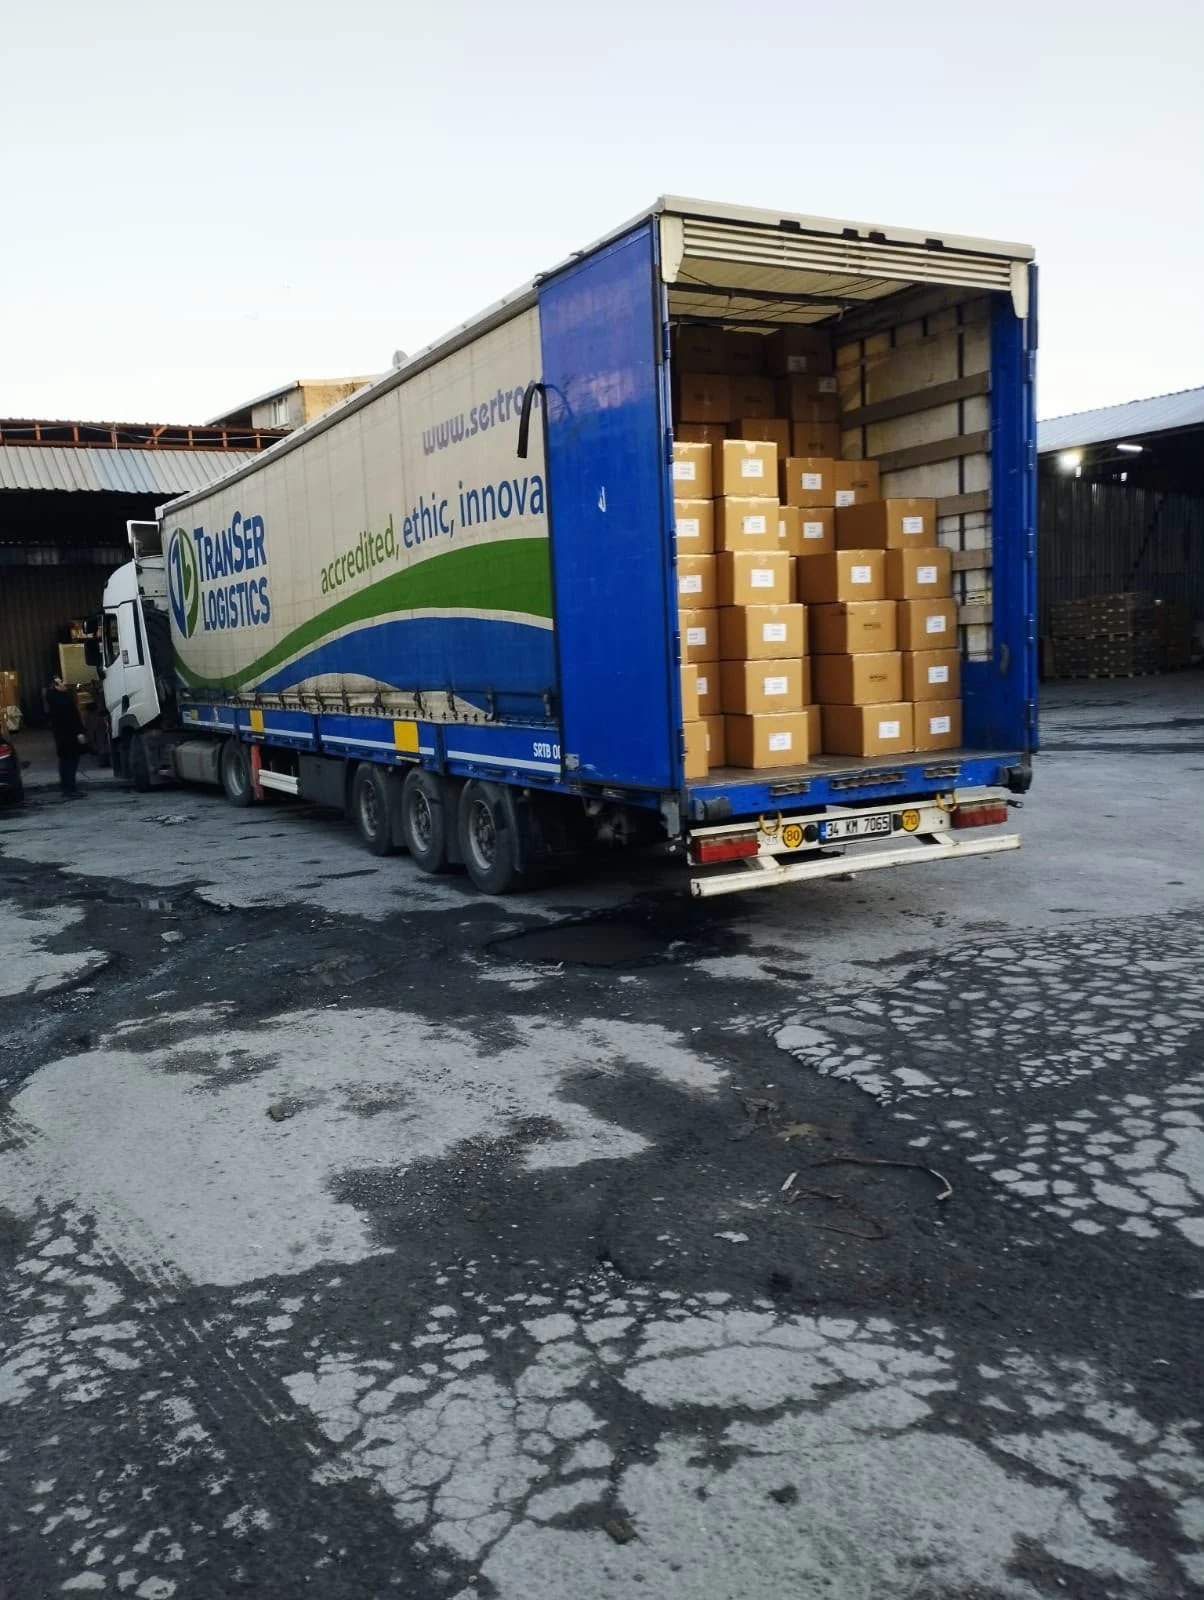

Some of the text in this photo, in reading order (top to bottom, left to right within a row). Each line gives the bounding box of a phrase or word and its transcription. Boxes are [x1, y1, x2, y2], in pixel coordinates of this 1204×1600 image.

[320, 474, 545, 595] accredited, ethic, innova
[202, 576, 270, 631] LOGISTICS
[533, 742, 551, 758] SRTB
[827, 816, 889, 837] 34 KM 7065
[904, 814, 917, 826] 70
[786, 829, 799, 842] 80
